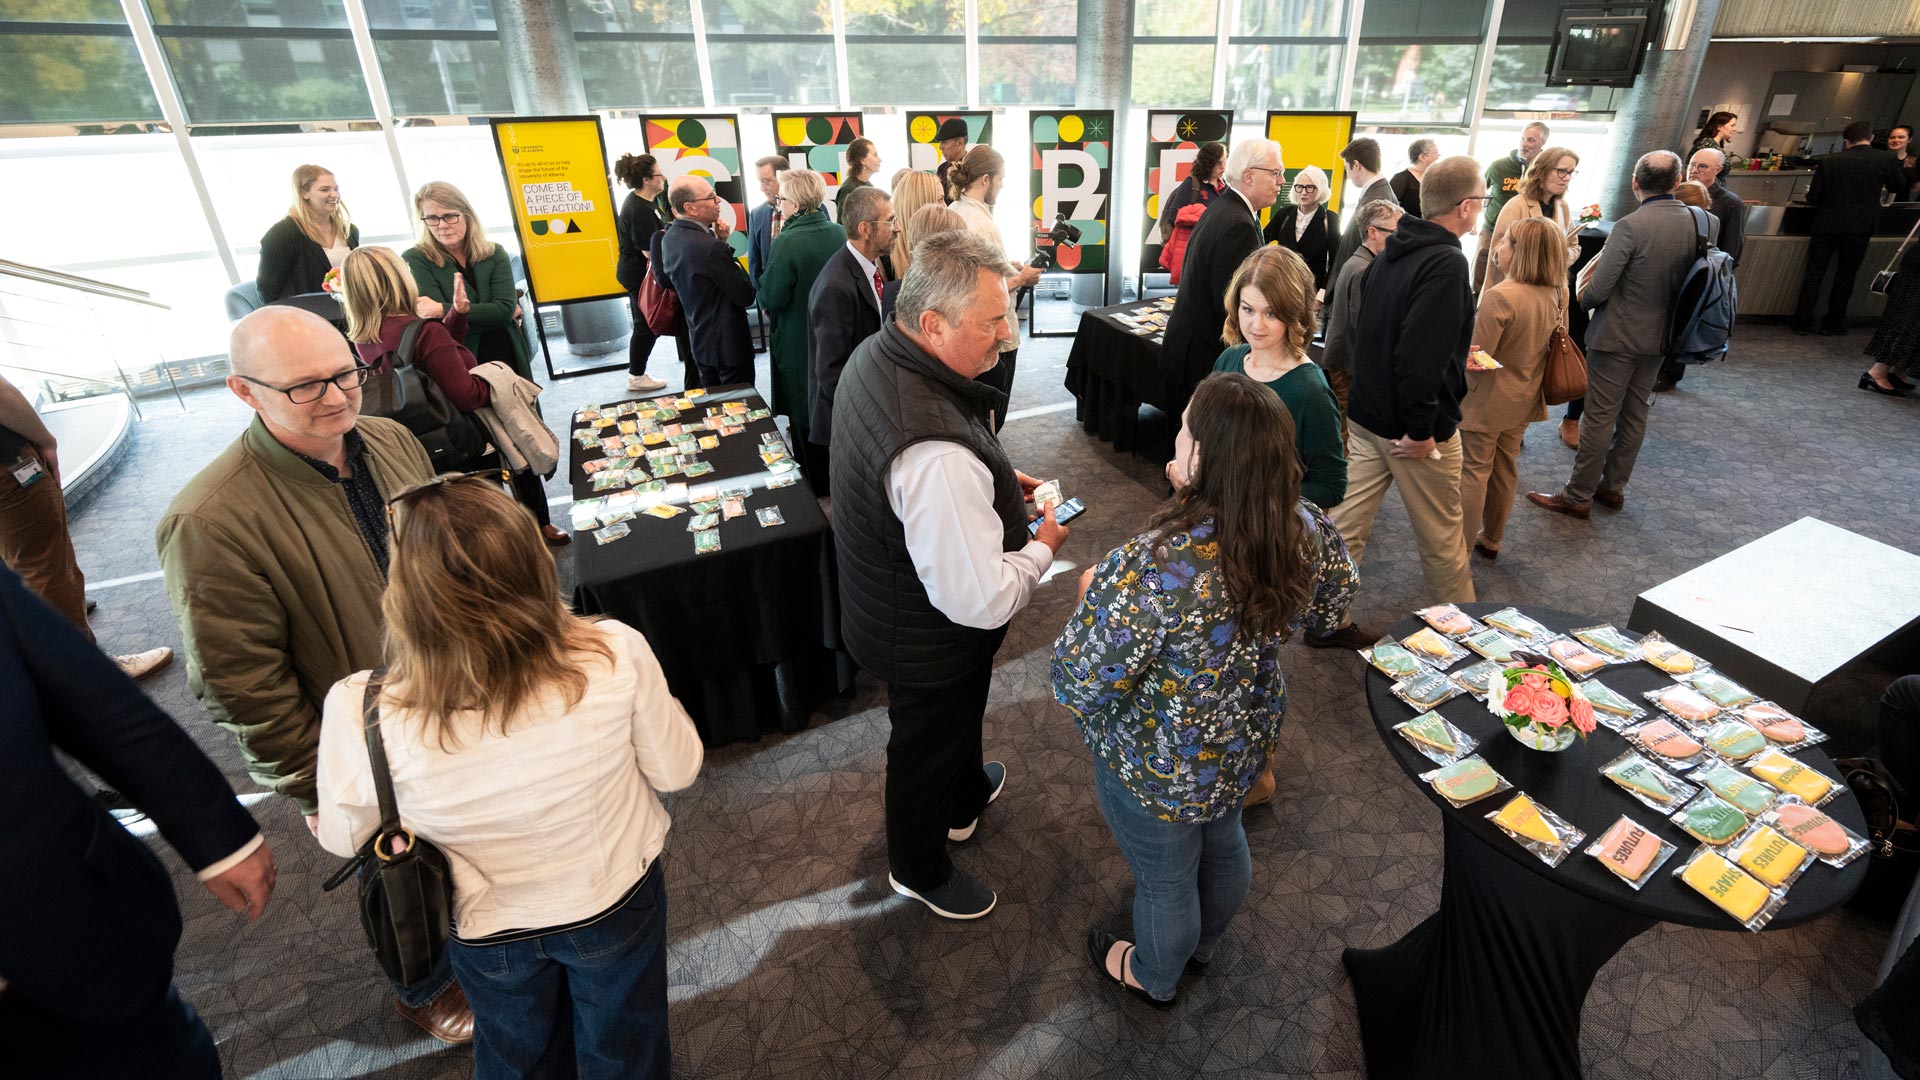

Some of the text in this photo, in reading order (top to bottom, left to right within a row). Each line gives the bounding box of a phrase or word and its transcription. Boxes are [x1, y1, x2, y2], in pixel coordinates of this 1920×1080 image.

[524, 182, 570, 194] COME BE
[526, 192, 580, 204] A PIECE OF
[528, 202, 592, 214] THE ACTION!
[1476, 633, 1501, 649] TRUST
[1757, 714, 1791, 728] TRUST
[1723, 778, 1752, 798] TRUST
[1511, 806, 1537, 828] IDEAS
[1696, 806, 1735, 833] FUTURES
[1791, 815, 1830, 836] FUTURES
[1611, 826, 1645, 865] FUTURES
[1752, 836, 1789, 869] FUTURES
[1709, 868, 1744, 898] SHAPE
